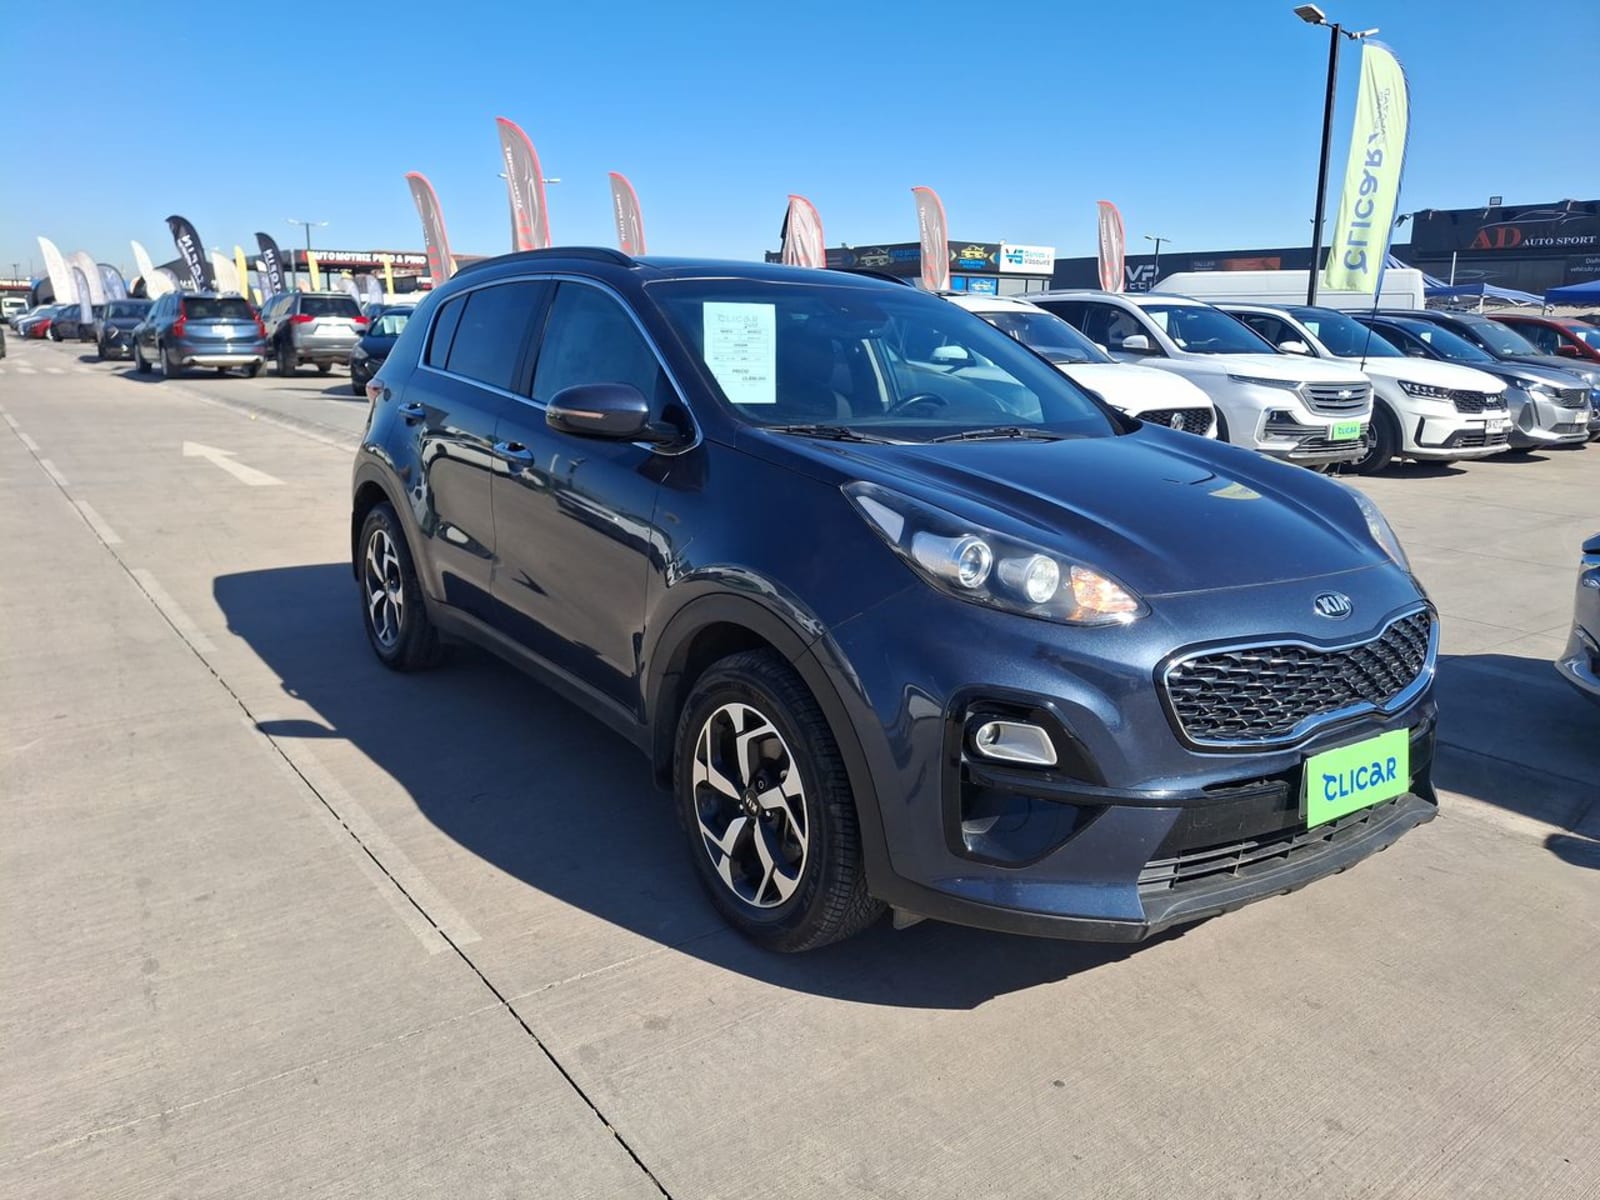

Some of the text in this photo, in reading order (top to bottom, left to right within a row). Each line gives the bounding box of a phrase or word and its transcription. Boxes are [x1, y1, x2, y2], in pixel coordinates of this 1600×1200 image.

[1470, 226, 1597, 249] AD AUTO SPORT
[1317, 594, 1350, 615] KIA
